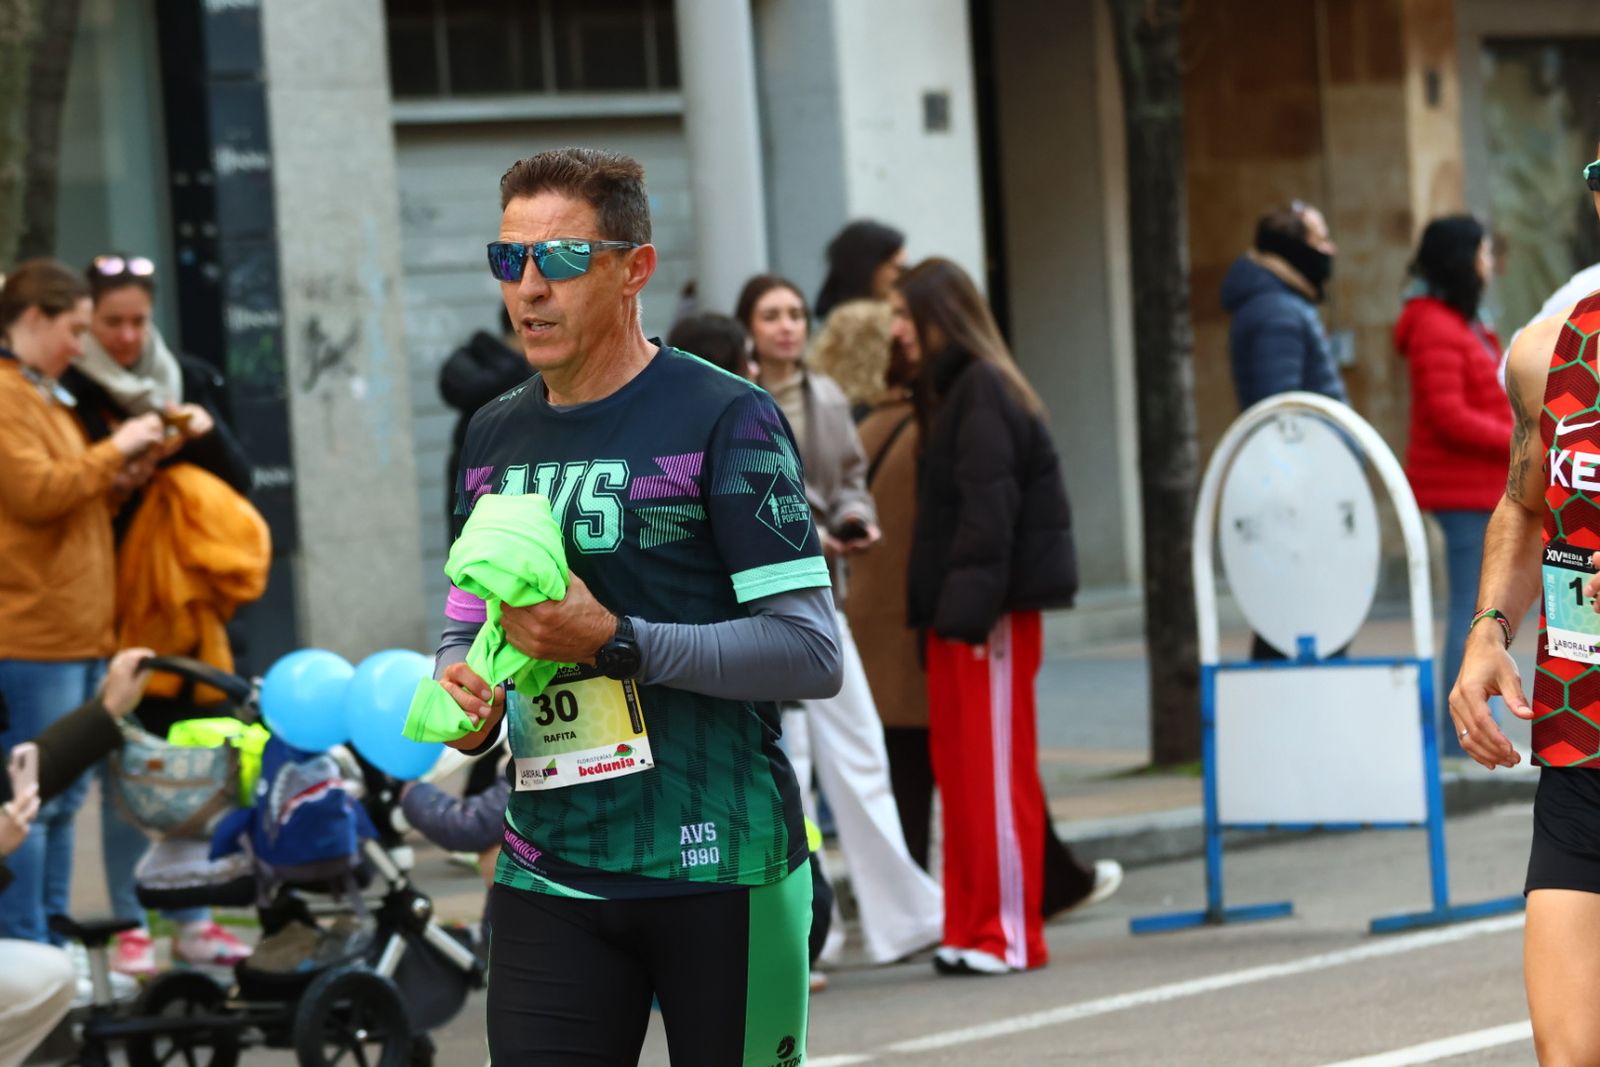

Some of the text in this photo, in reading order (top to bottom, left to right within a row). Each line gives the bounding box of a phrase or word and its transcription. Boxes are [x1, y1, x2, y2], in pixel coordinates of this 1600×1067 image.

[1546, 549, 1583, 562] XIV MEDIA
[1553, 638, 1588, 652] LABORAL
[532, 690, 579, 726] 30
[543, 731, 577, 743] RAFITA
[578, 758, 635, 777] bedunia
[680, 822, 717, 845] AVS
[680, 847, 719, 868] 1990
